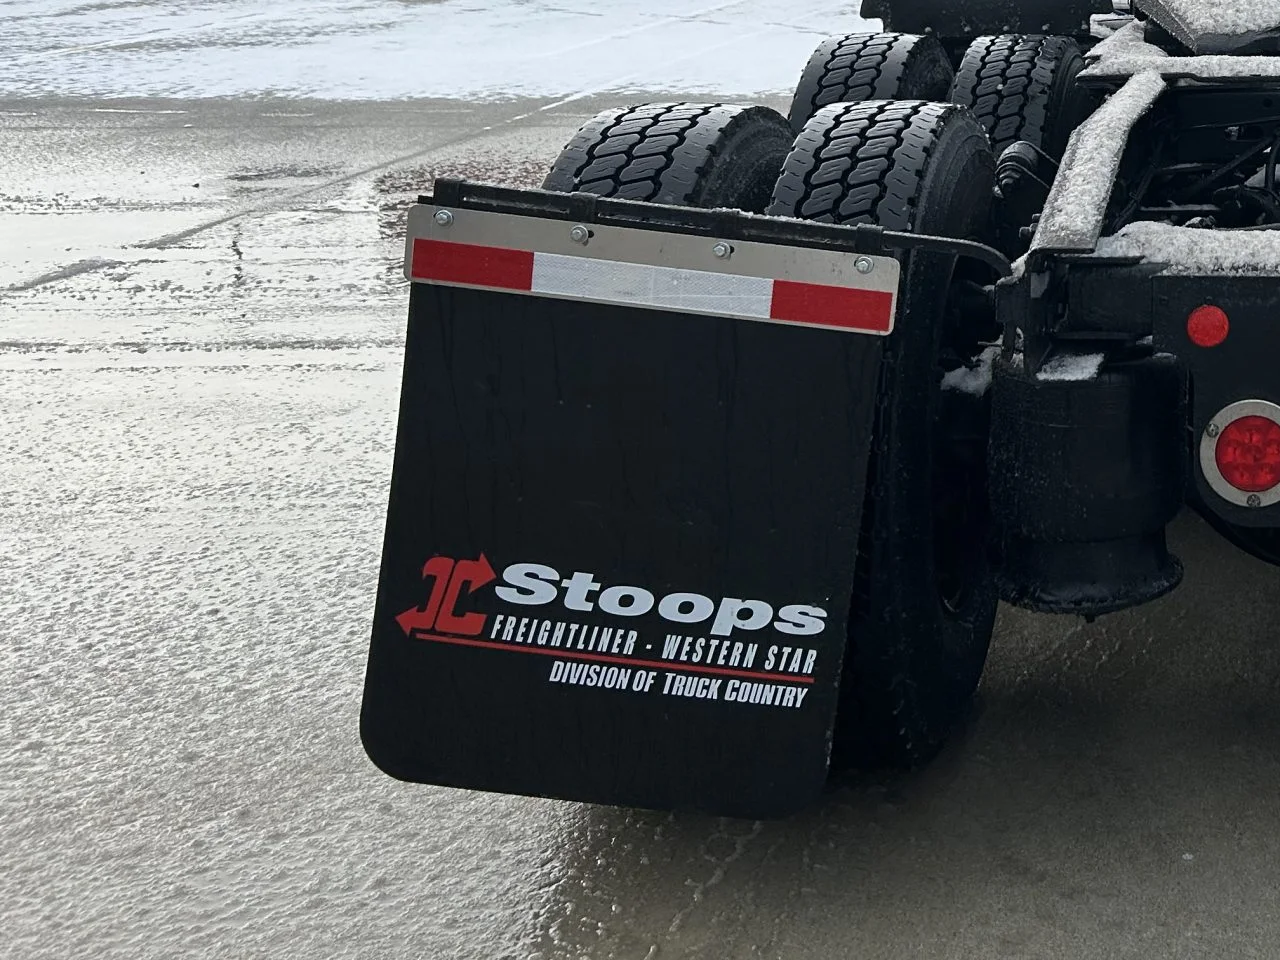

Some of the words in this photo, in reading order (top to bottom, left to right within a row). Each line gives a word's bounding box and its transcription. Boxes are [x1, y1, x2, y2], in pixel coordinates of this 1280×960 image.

[494, 562, 828, 637] Stoops
[490, 614, 638, 656] FREIGHTLINER
[661, 634, 759, 668] WESTERN
[764, 644, 818, 674] STAR
[548, 660, 632, 690] DIVISION
[632, 669, 658, 693] OF
[662, 672, 723, 700] TRUCK
[723, 679, 809, 708] COUNTRY
